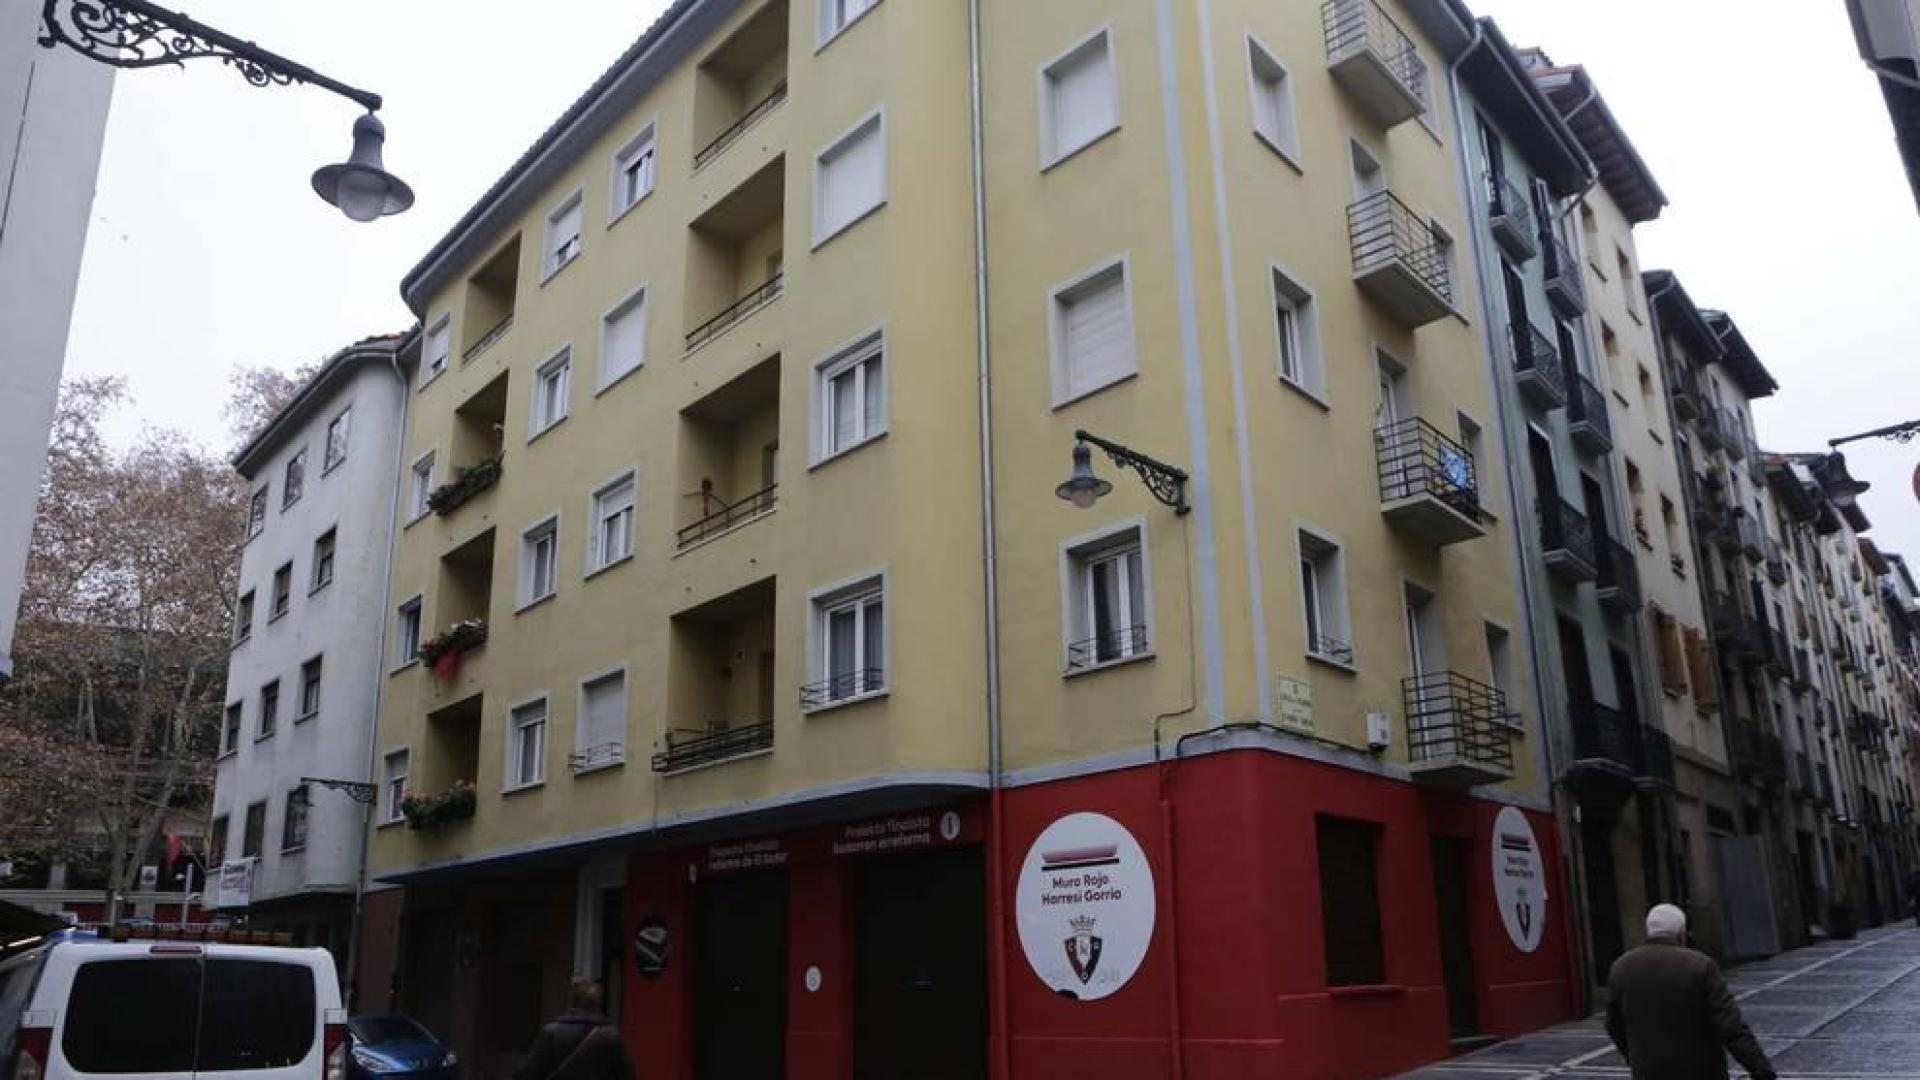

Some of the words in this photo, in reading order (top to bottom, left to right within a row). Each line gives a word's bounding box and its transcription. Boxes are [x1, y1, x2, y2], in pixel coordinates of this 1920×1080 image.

[1053, 875, 1081, 889] Muro
[1084, 872, 1110, 889] Rojo
[1042, 889, 1082, 905] Harresi
